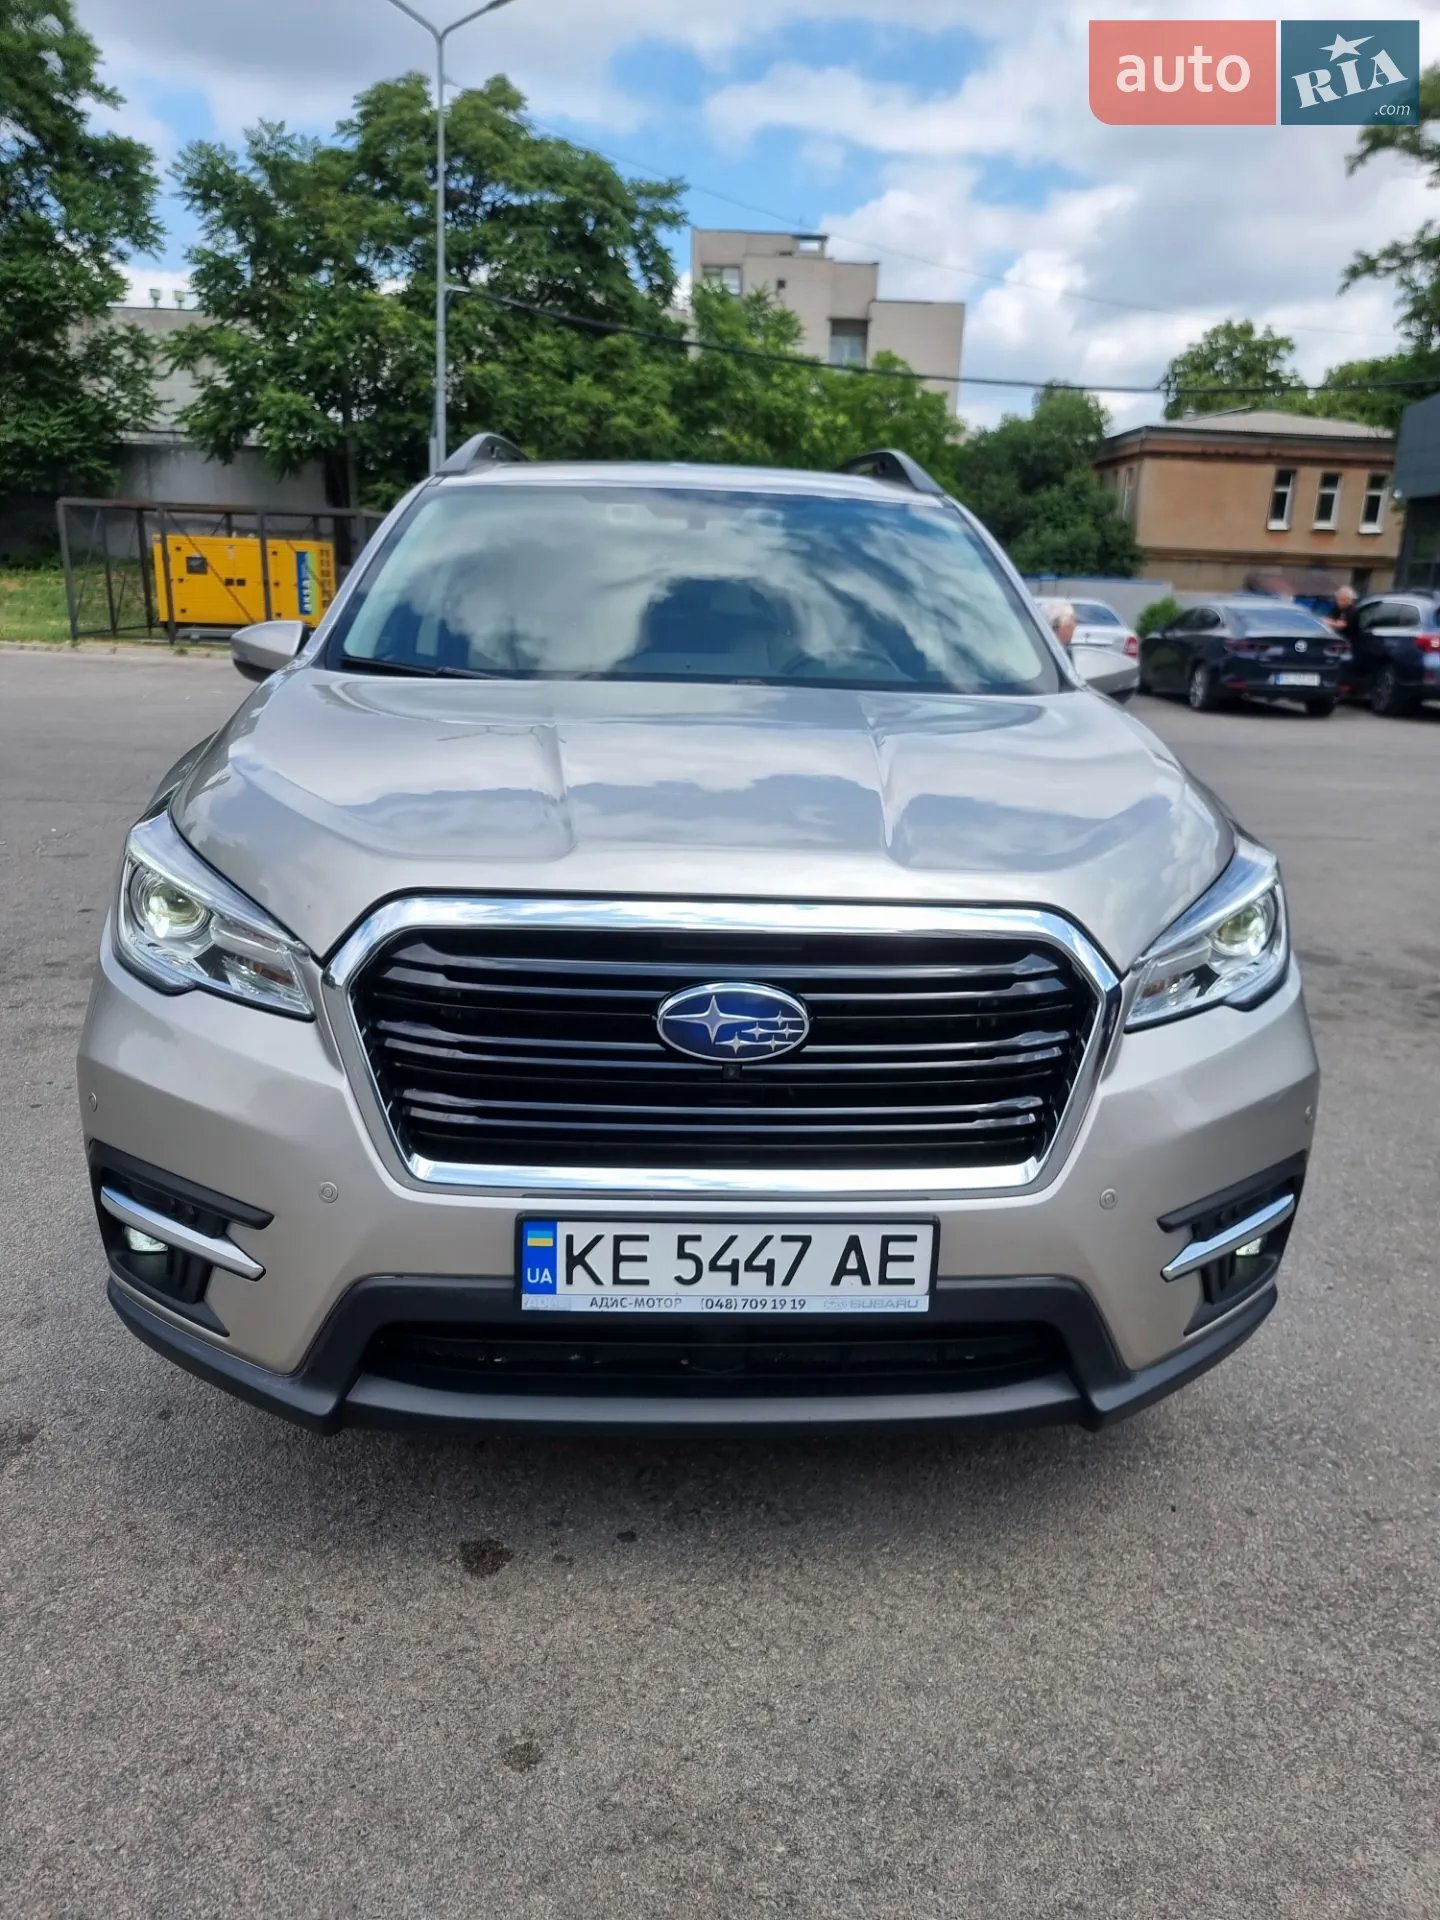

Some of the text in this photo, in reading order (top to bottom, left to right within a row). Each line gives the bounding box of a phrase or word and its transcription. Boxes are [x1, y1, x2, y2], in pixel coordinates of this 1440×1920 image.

[565, 1234, 918, 1286] KE 5447 AE
[527, 1267, 553, 1284] UA
[590, 1297, 682, 1310] АДИС-МОТОР
